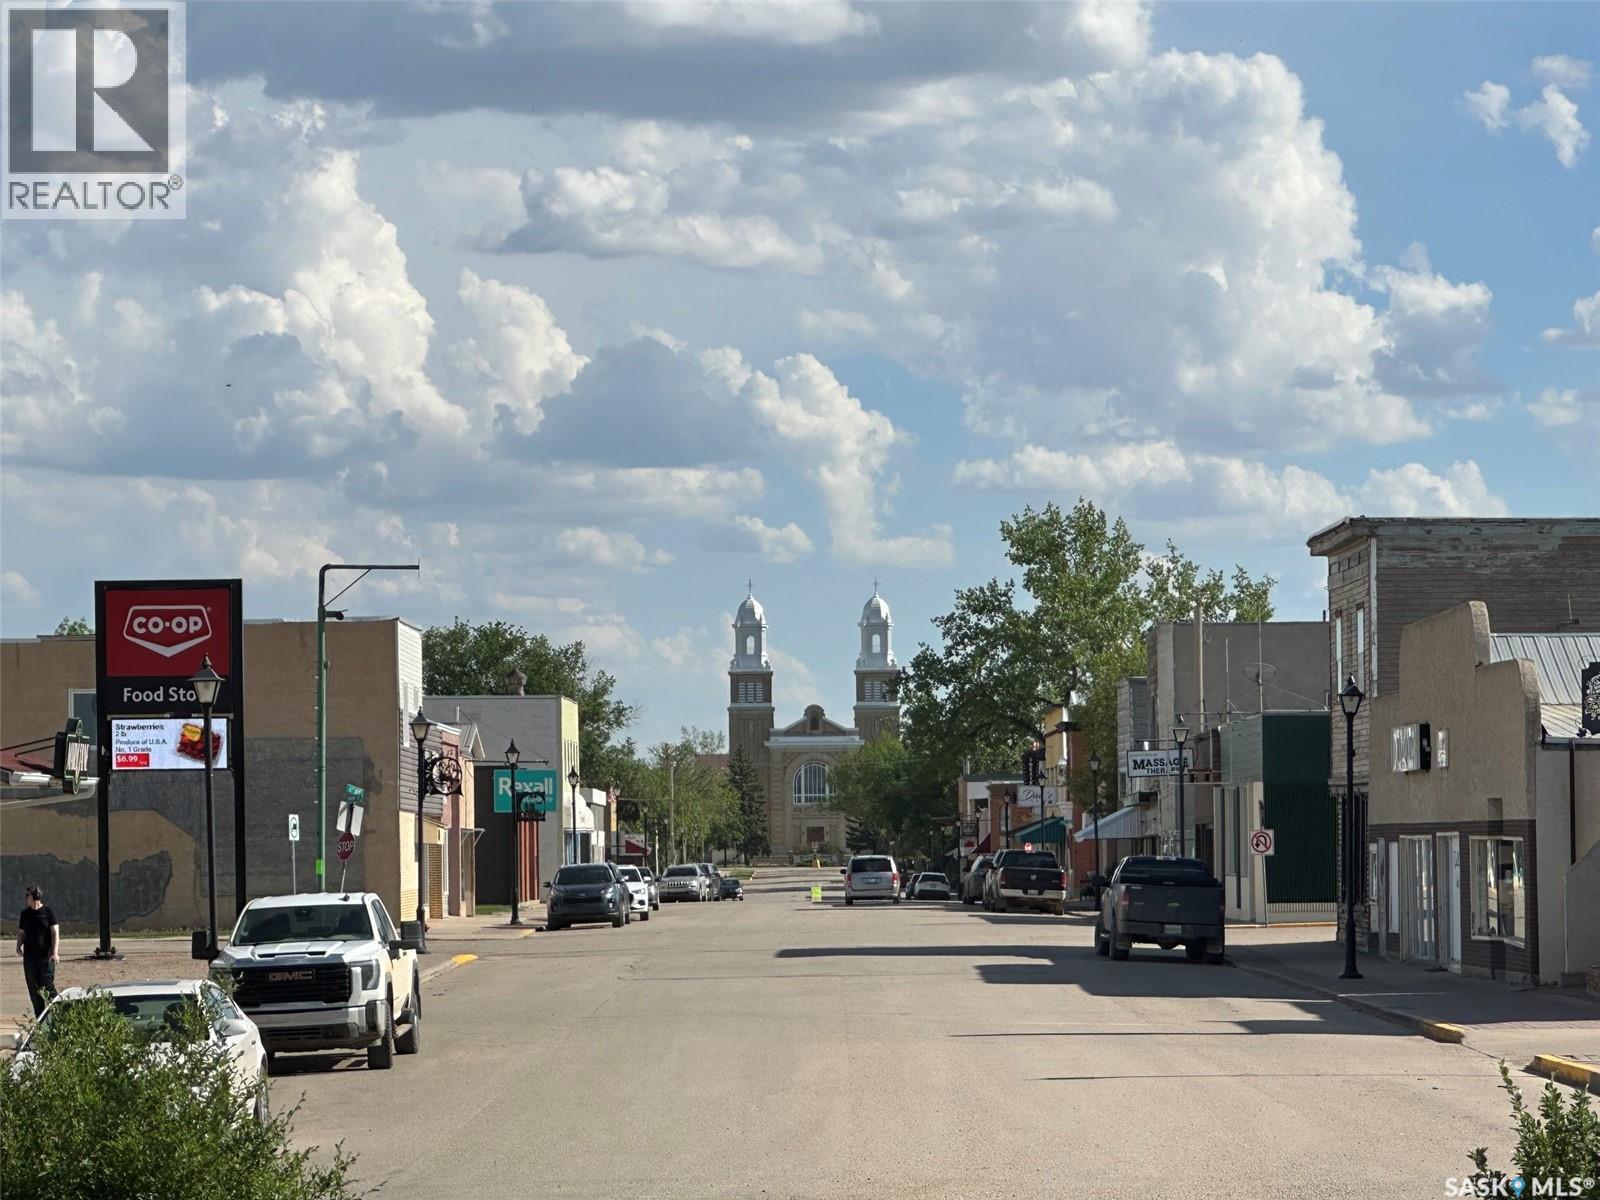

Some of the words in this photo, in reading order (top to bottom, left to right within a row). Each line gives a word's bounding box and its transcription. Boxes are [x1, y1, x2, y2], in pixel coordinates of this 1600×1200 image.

[123, 686, 164, 702] Food
[168, 687, 197, 702] Sto
[116, 755, 138, 763] $6.99
[337, 840, 354, 853] STOP
[268, 970, 313, 981] GMC
